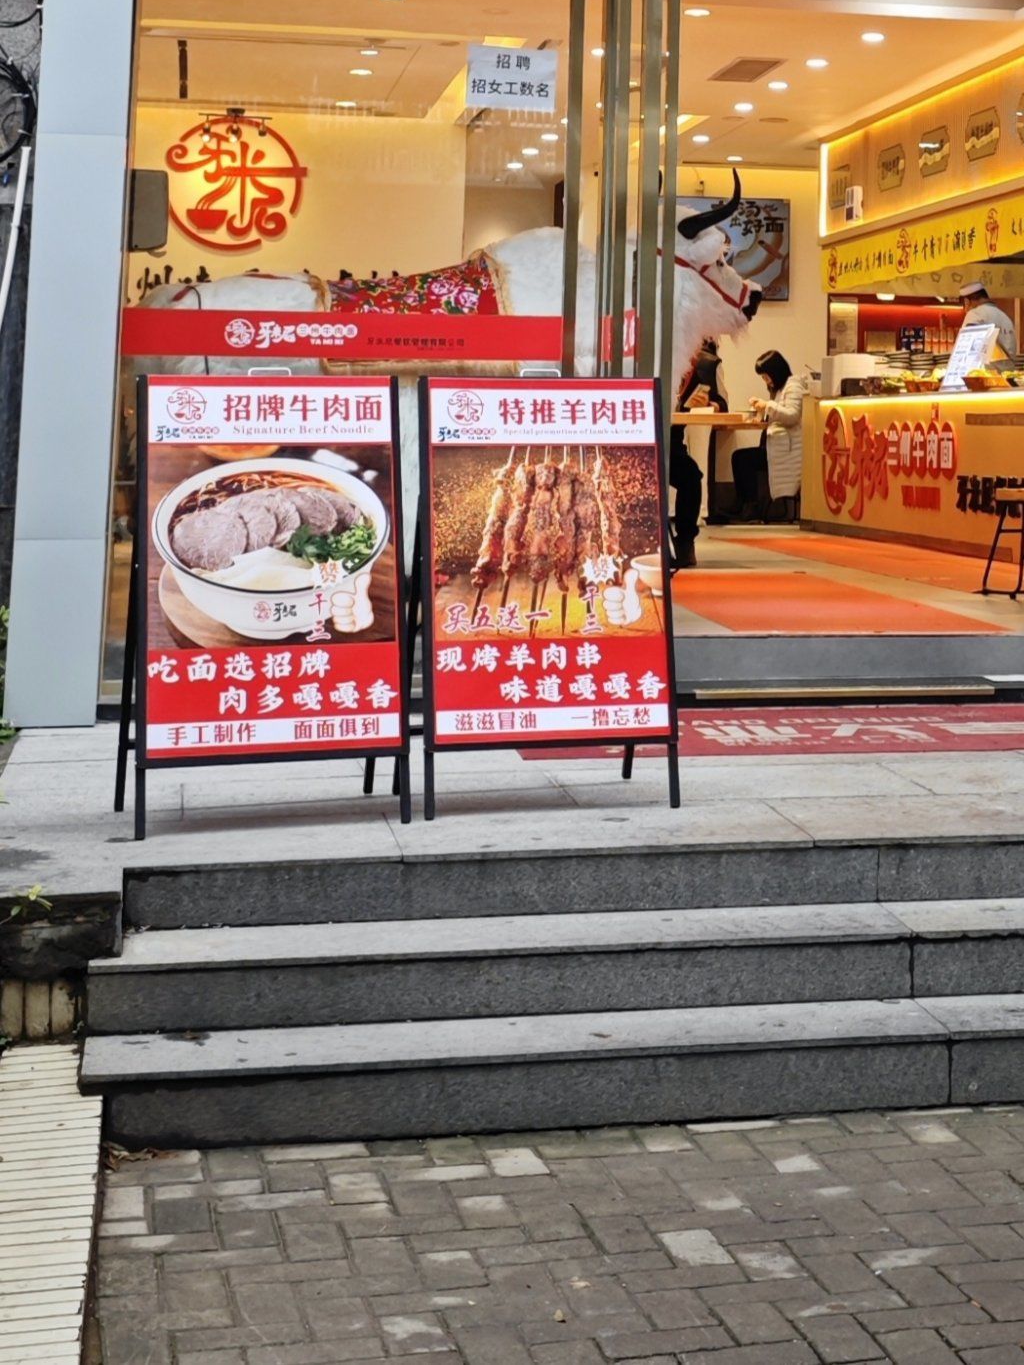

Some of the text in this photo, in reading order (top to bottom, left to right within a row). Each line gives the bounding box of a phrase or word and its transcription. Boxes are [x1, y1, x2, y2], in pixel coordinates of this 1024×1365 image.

[496, 53, 532, 71] 招聘
[471, 77, 550, 98] 招女工数名
[222, 393, 384, 424] 招牌牛肉面
[499, 398, 647, 426] 特推羊肉串
[232, 424, 296, 436] Signature
[299, 424, 327, 435] Beef
[329, 424, 375, 435] Noodle
[886, 429, 954, 470] 兰州牛肉面
[147, 648, 332, 684] 吃面选招牌
[435, 641, 603, 674] 现烤羊肉串
[218, 677, 400, 715] 肉多嘎嘎香
[499, 670, 668, 704] 味道嘎嘎香
[166, 715, 381, 747] 手工制作 面面俱到
[454, 710, 538, 732] 滋滋冒油
